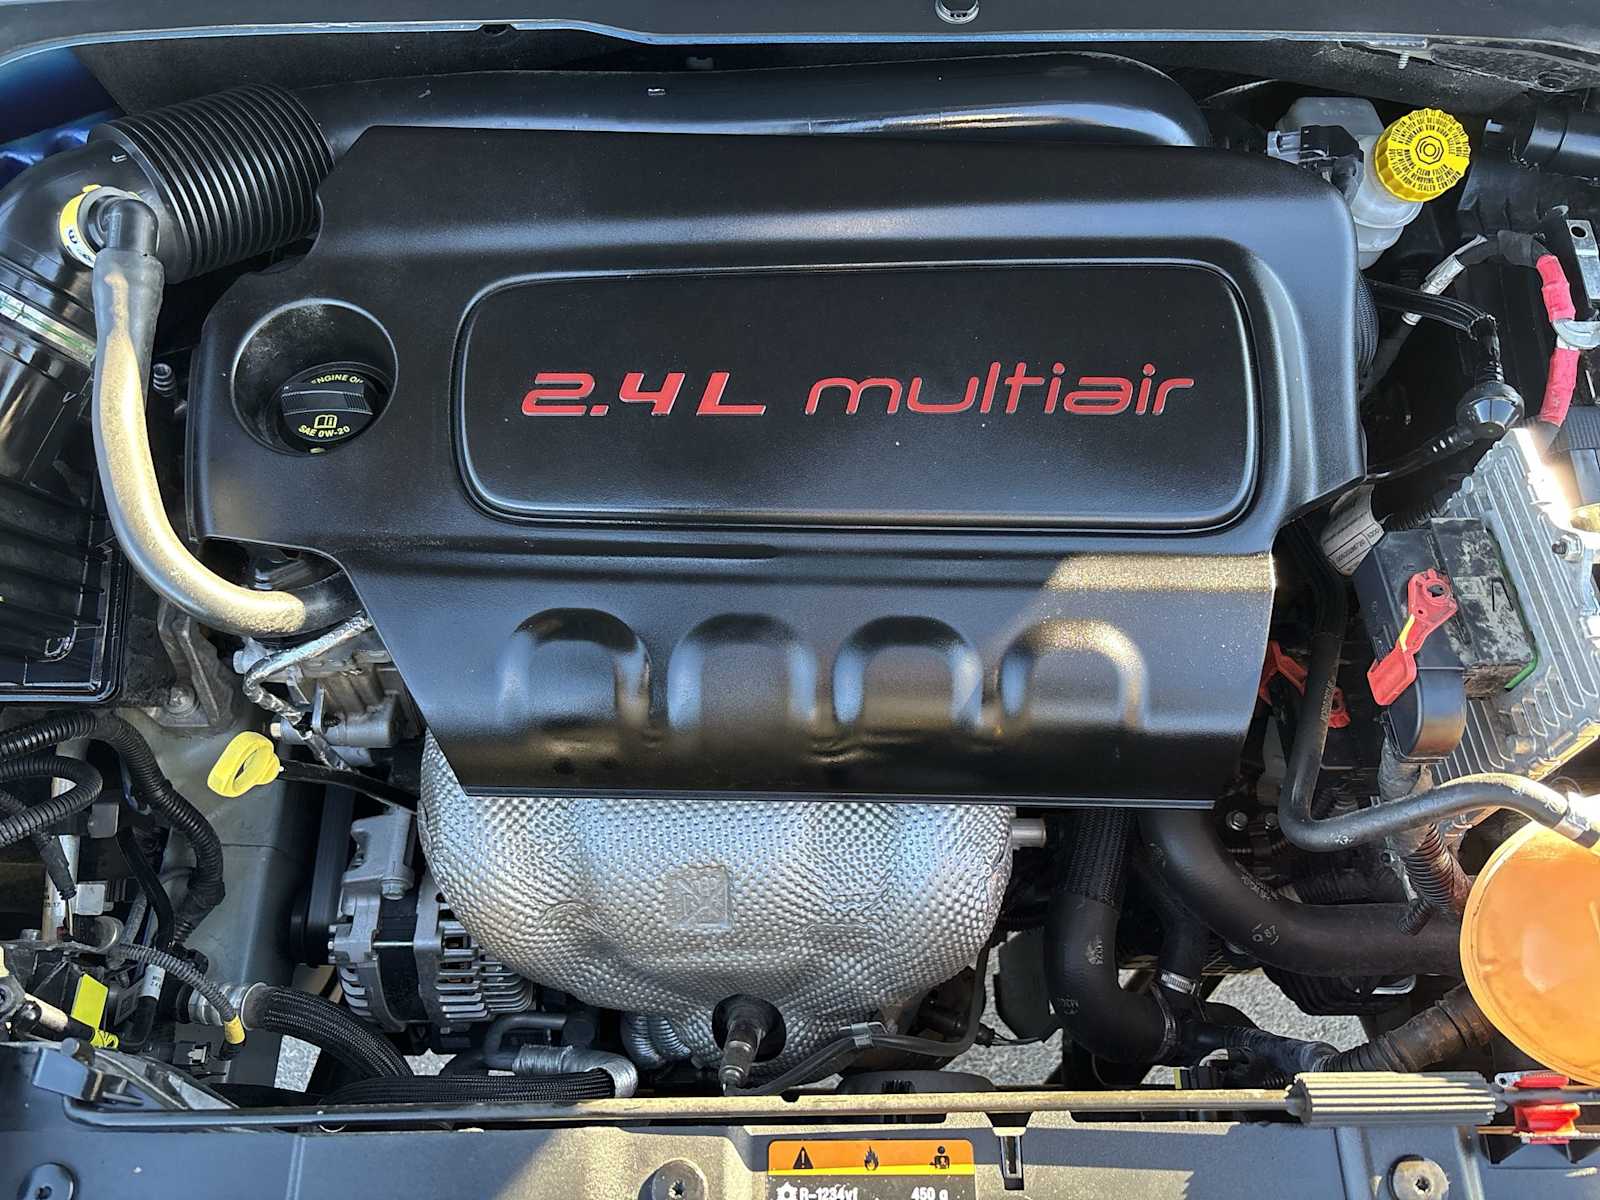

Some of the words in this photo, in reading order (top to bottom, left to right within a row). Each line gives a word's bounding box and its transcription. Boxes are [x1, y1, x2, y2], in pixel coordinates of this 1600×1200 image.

[805, 362, 1194, 415] multiair
[298, 424, 317, 437] SAE
[318, 425, 350, 438] 0W-20
[911, 1186, 936, 1200] 450
